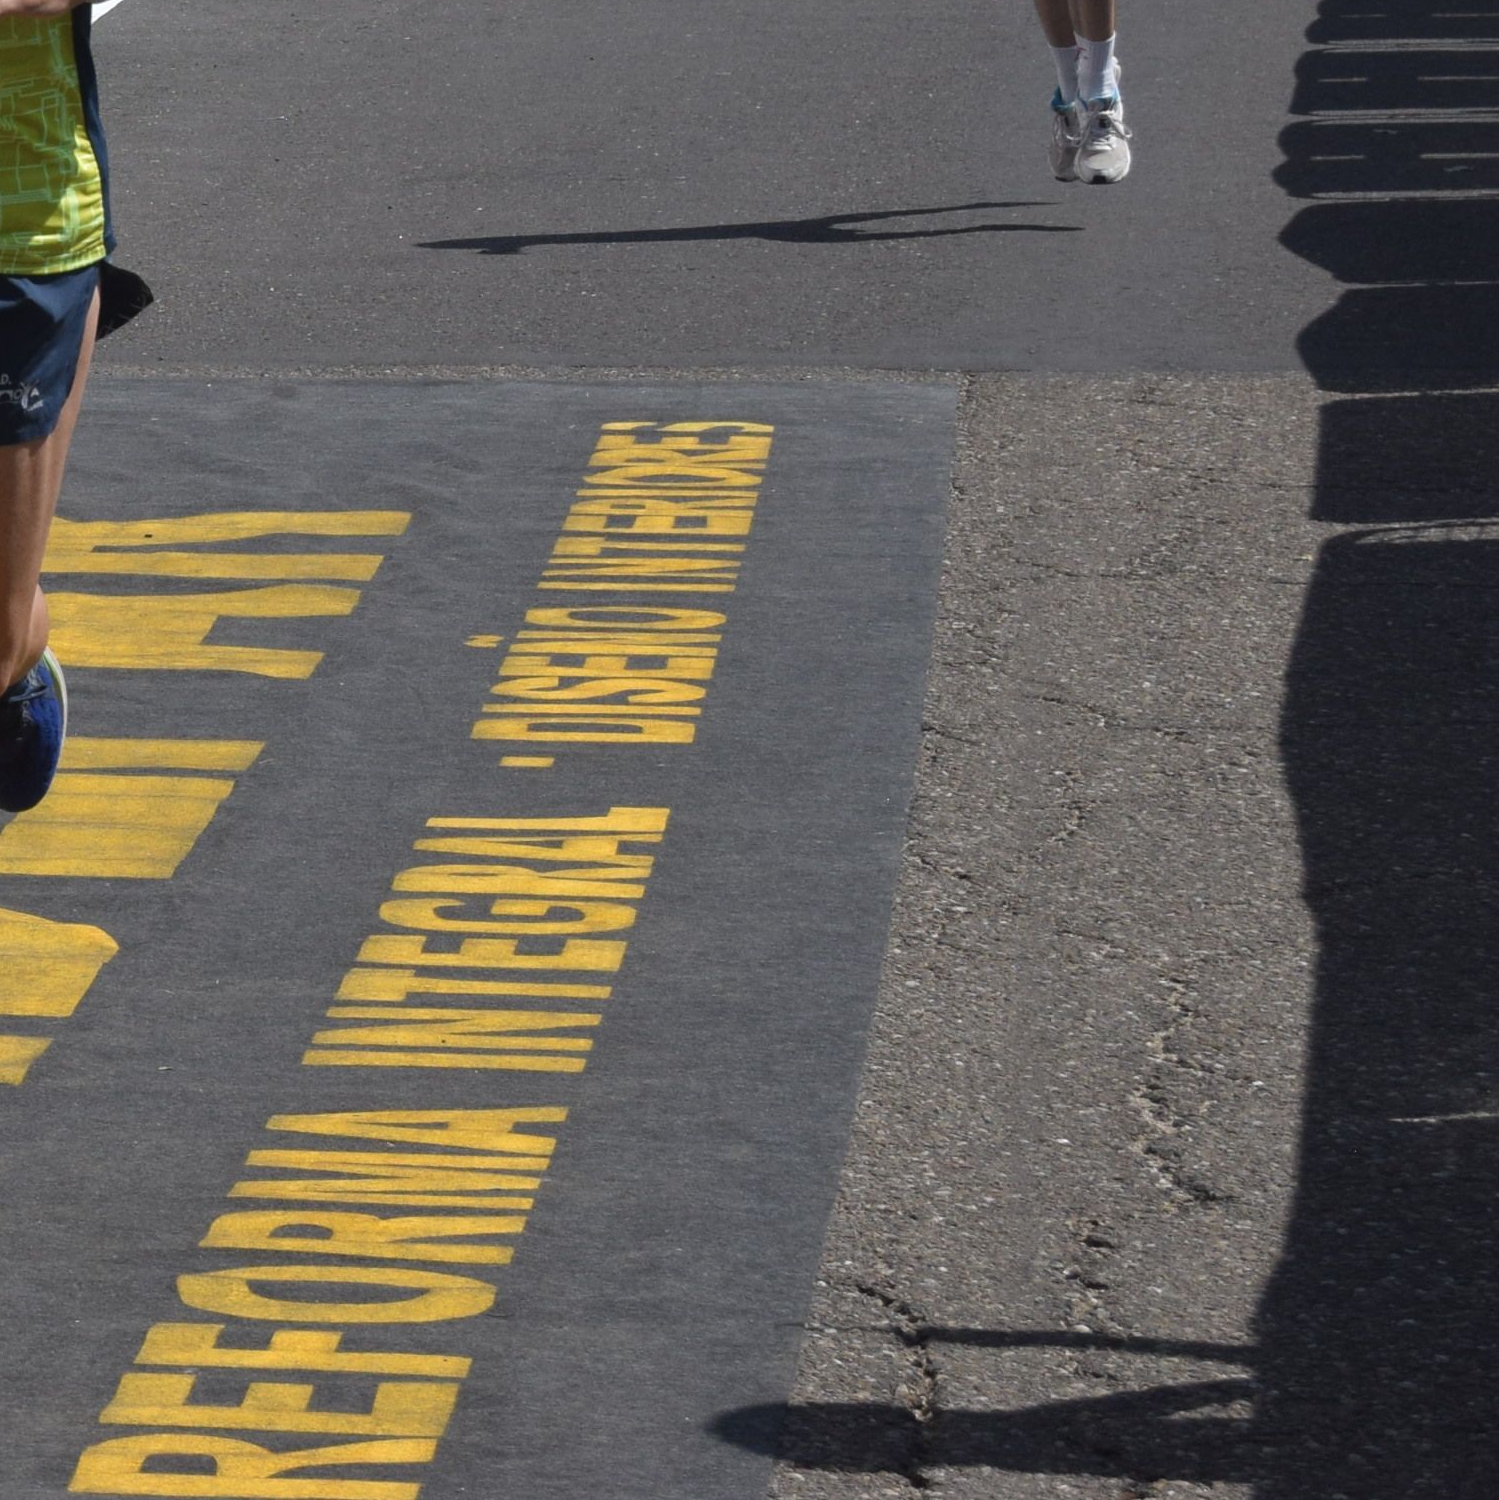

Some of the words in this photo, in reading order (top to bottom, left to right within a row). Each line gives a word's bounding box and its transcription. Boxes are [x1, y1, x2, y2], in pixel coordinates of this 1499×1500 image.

[537, 421, 775, 592] INTERIORES
[464, 606, 728, 744] DISEÑO
[302, 806, 672, 1073] INTEGRAL
[67, 1106, 570, 1500] REFORMA
